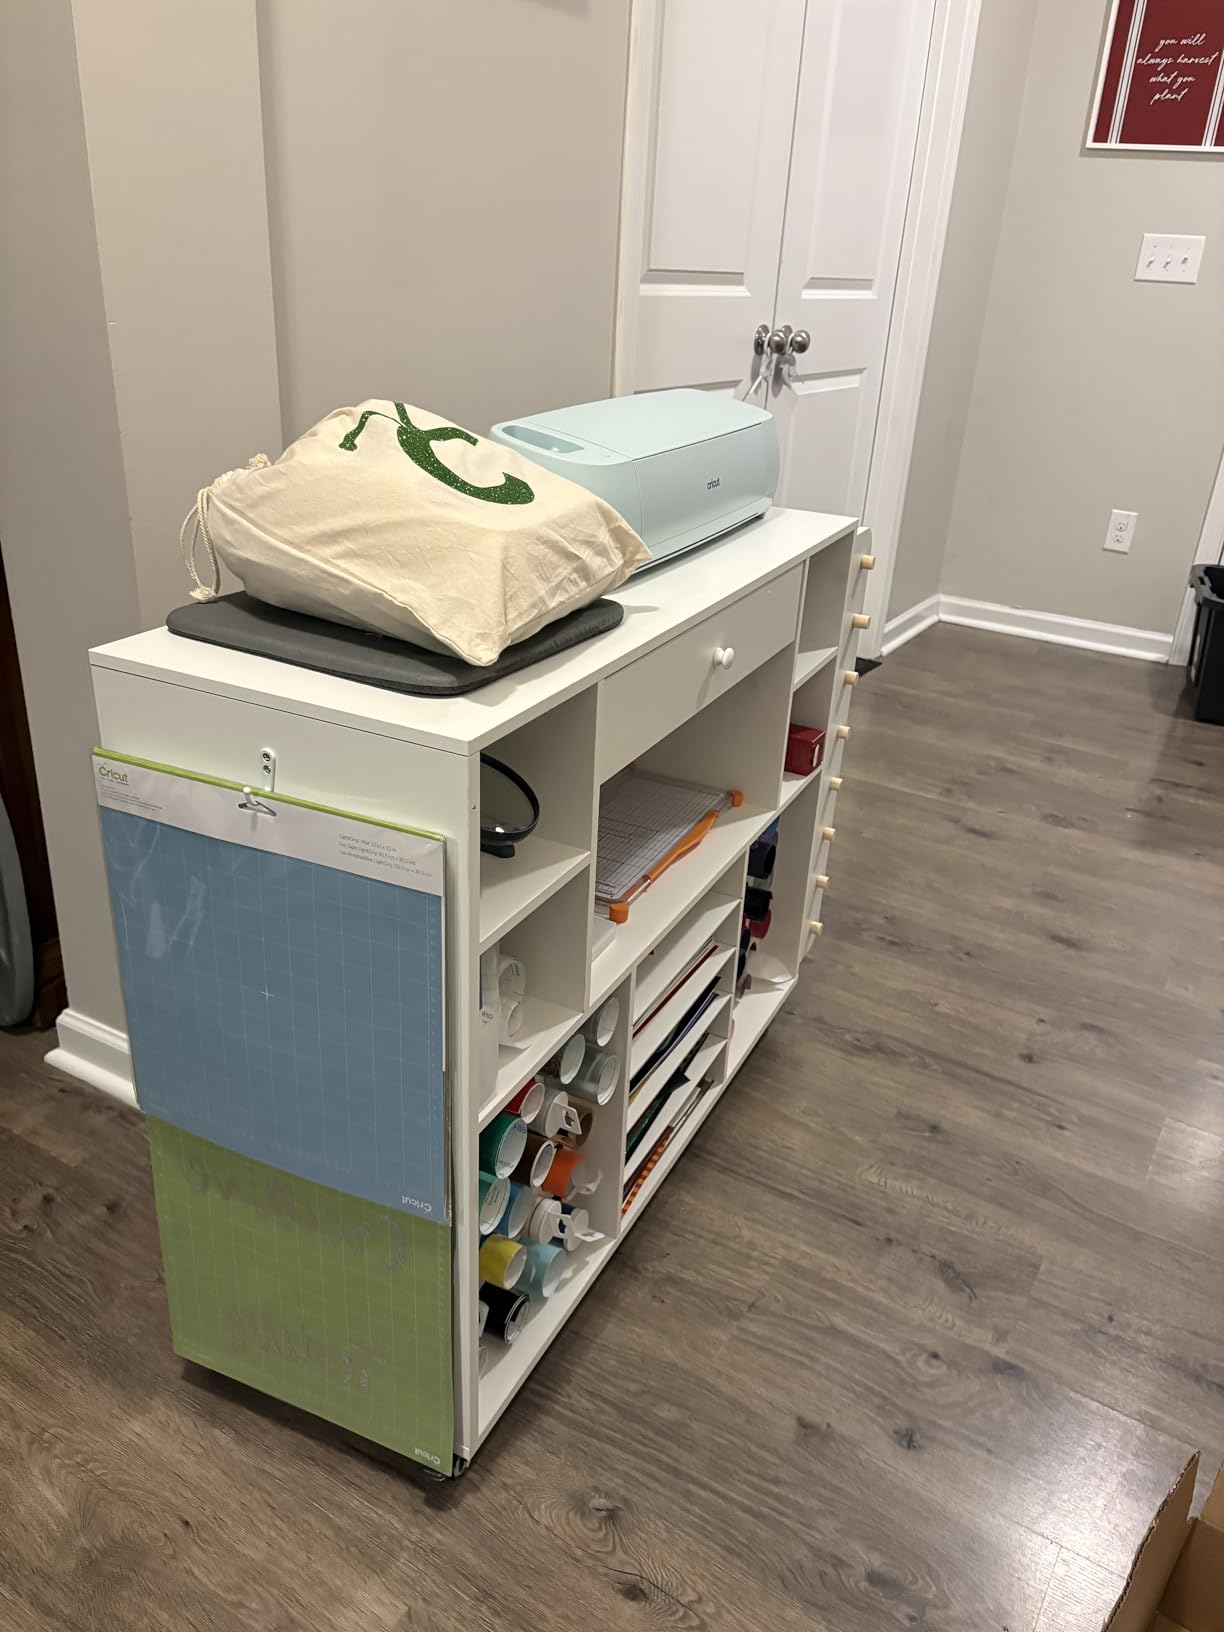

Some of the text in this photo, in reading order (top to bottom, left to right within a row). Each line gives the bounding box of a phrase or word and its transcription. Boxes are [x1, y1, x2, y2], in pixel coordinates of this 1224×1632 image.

[1154, 33, 1207, 53] you will
[1136, 51, 1220, 72] always harvest
[1149, 71, 1197, 90] what you
[1149, 88, 1190, 106] plant
[98, 766, 129, 783] Cricut
[401, 1195, 432, 1212] Cricut
[414, 1447, 441, 1465] Cricut
